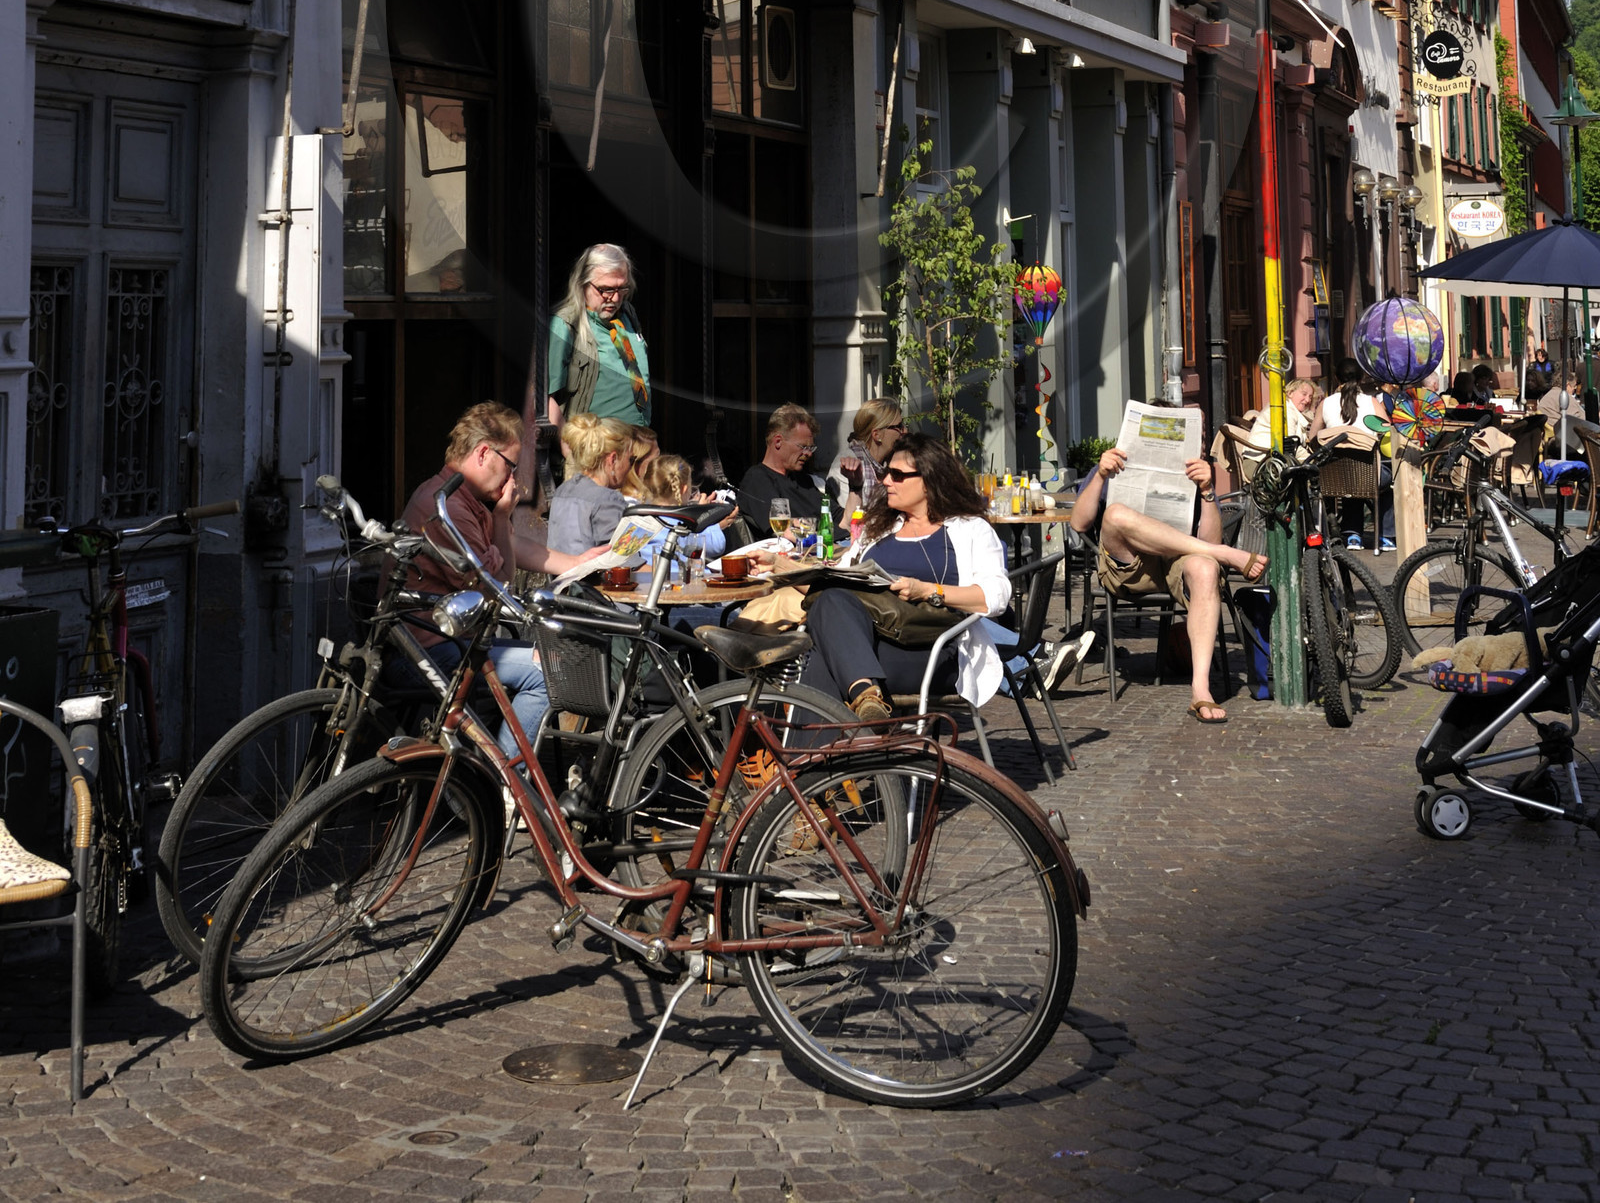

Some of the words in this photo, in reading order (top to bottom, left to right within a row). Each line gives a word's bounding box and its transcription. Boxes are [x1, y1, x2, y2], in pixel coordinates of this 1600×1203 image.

[1416, 78, 1469, 93] Restaurant
[1450, 211, 1481, 220] Restaurant
[1481, 210, 1501, 219] KOREA
